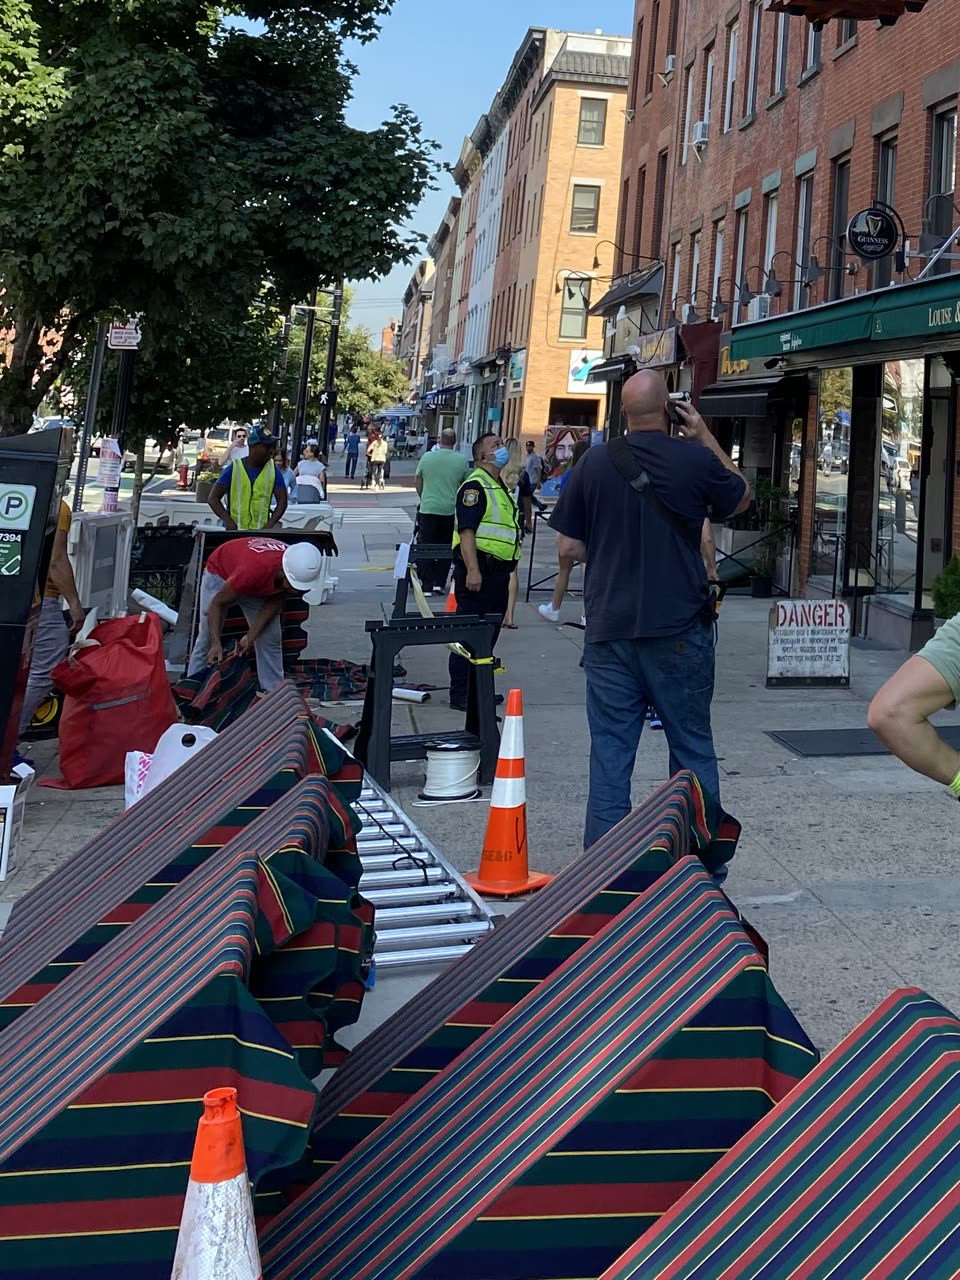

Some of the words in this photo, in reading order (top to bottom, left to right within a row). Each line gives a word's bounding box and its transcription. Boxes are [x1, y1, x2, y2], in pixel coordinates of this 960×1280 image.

[857, 235, 889, 244] GUINNESS
[928, 307, 952, 327] LOUISE
[776, 603, 846, 627] DANGER
